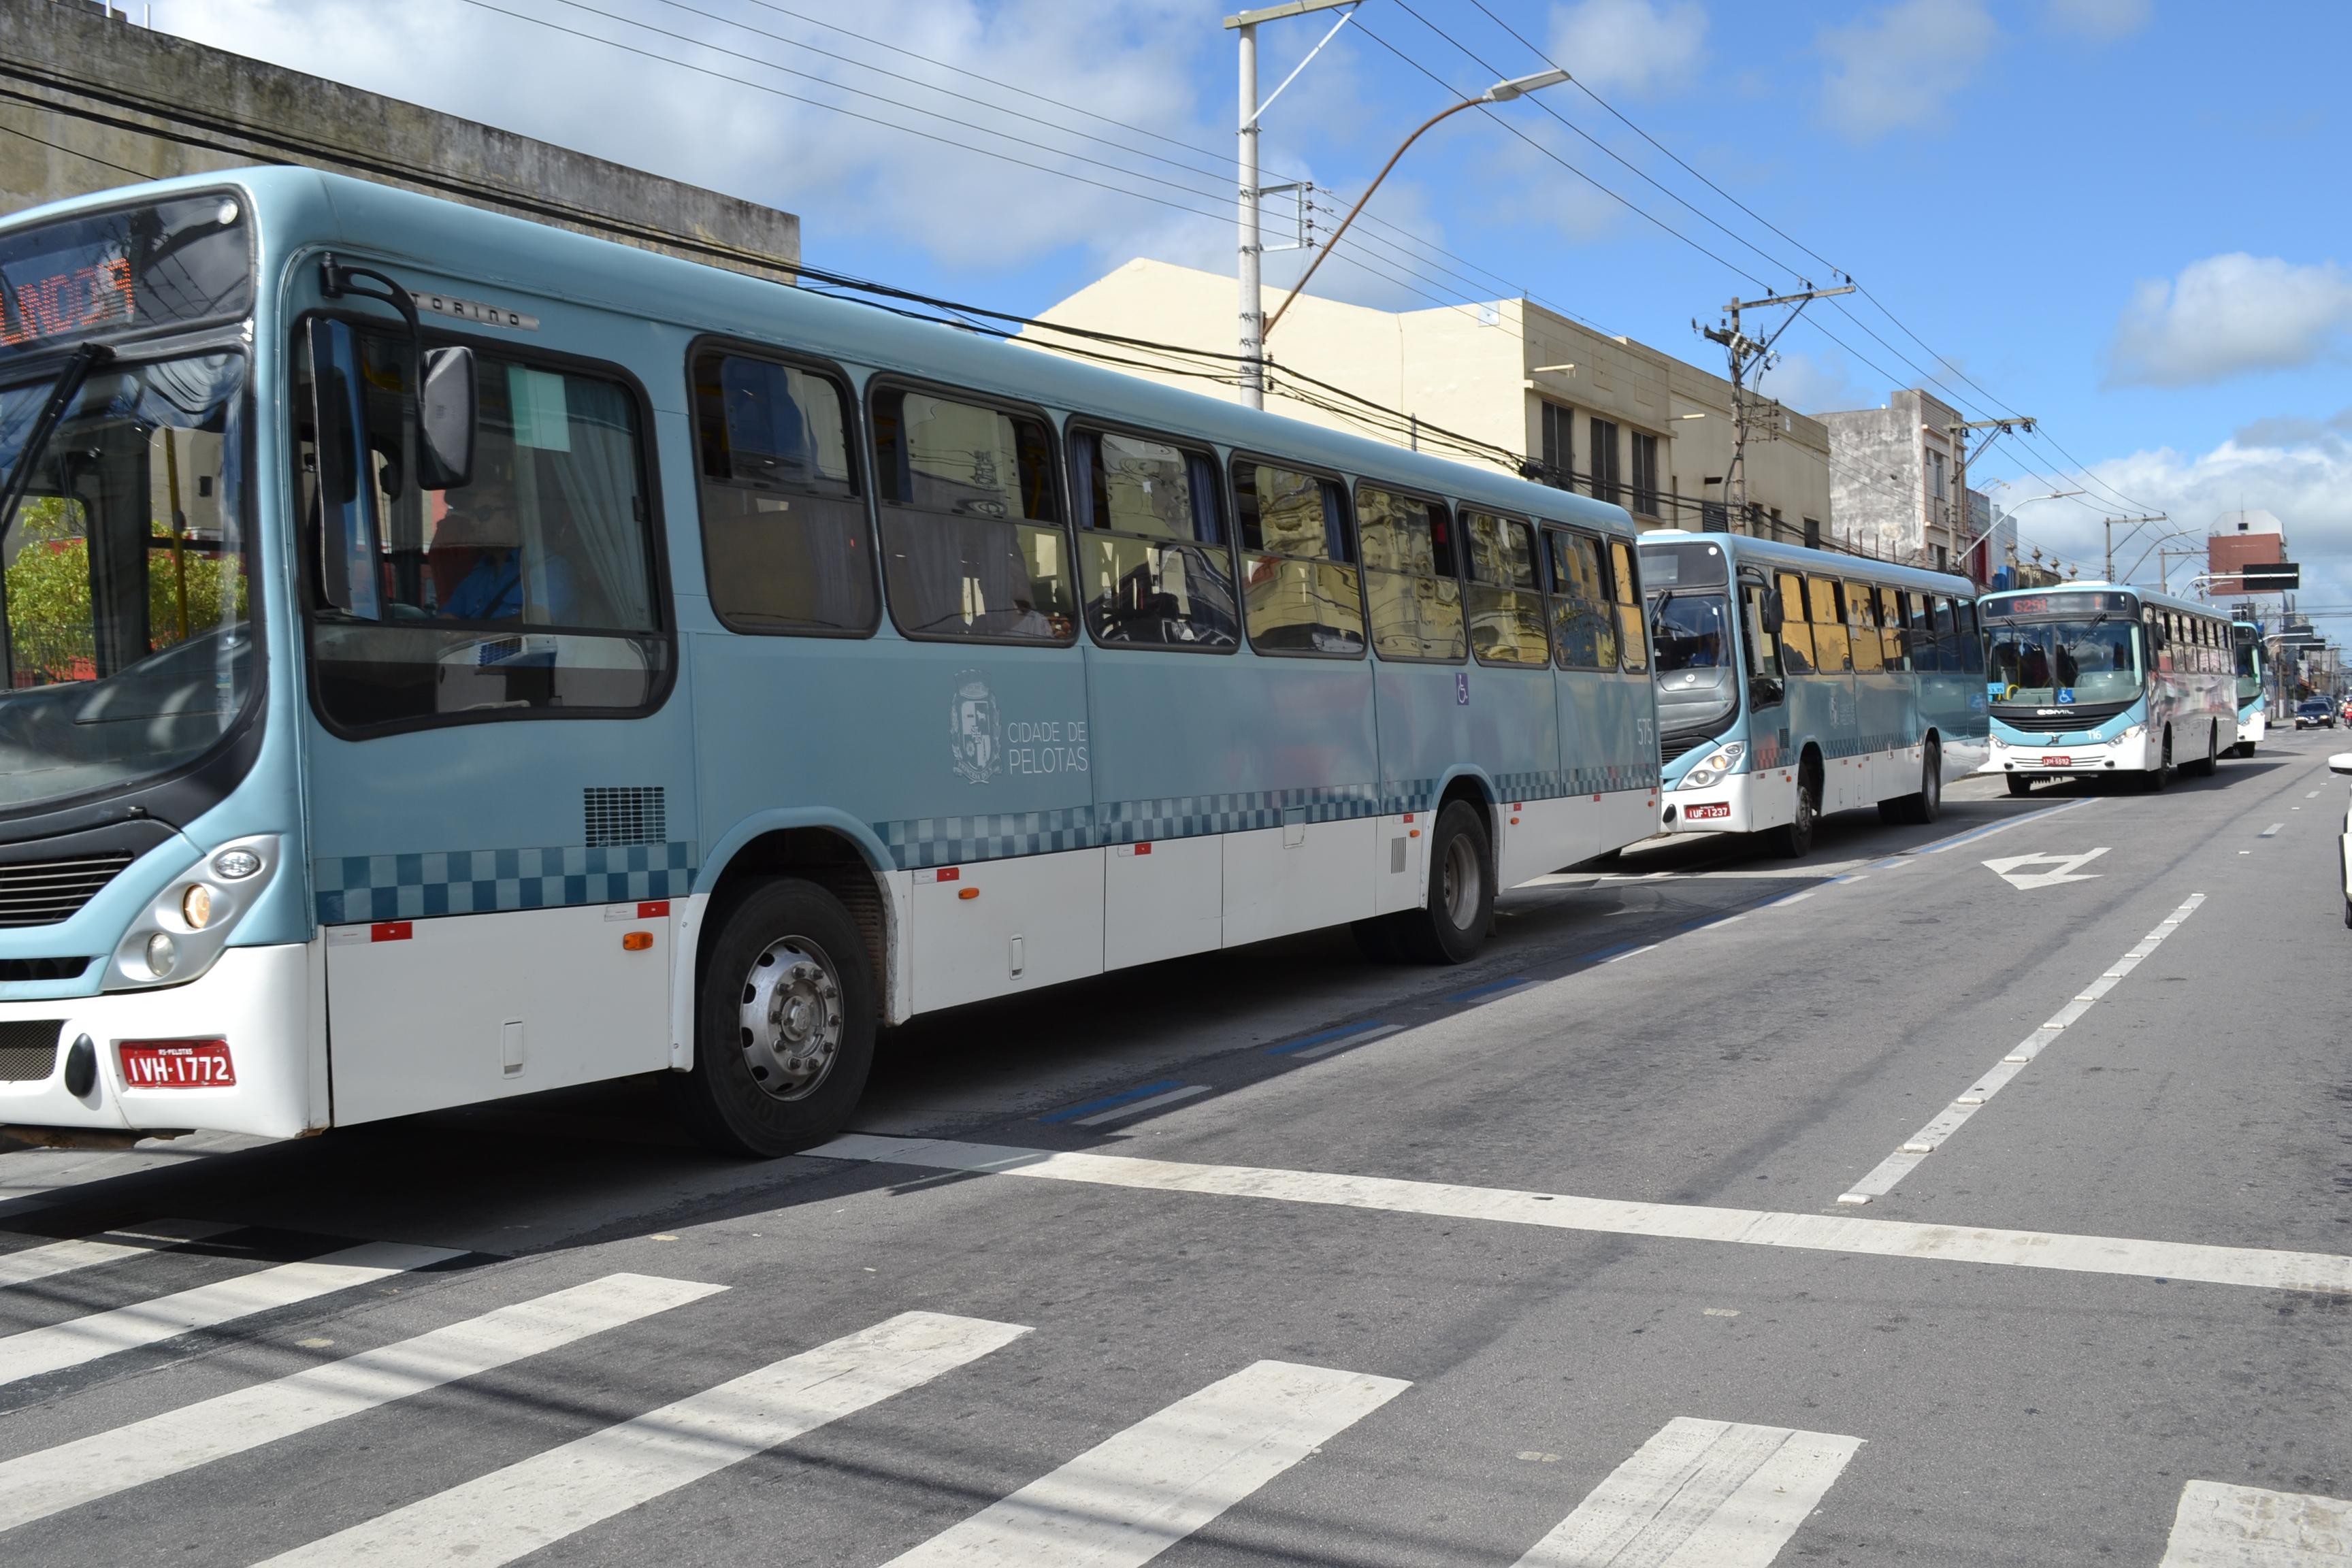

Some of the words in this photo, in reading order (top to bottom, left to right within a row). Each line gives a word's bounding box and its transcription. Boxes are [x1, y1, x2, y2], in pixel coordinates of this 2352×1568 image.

[410, 293, 520, 326] TORINO
[1008, 722, 1061, 743] CIDADE
[1068, 721, 1087, 742] DE
[1637, 718, 1653, 745] 575
[2087, 730, 2102, 740] 116
[1009, 747, 1089, 774] PELOTAS
[129, 1056, 230, 1082] IVH-1772
